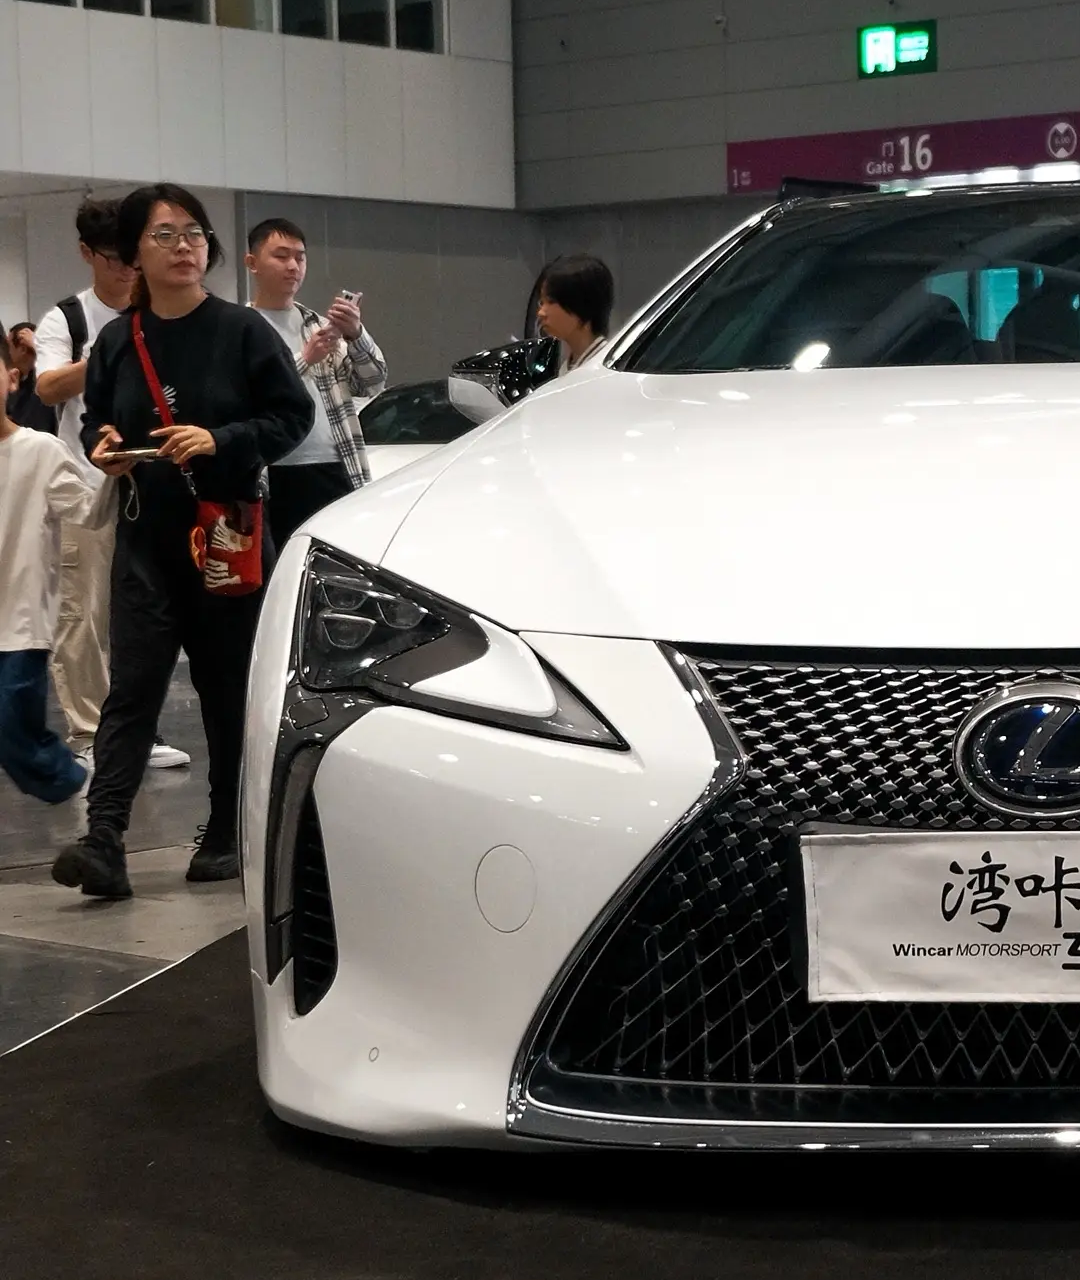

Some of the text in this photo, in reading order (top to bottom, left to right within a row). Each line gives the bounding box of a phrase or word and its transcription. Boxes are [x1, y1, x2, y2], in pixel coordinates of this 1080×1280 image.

[899, 133, 933, 172] 16
[866, 160, 895, 175] Gate
[892, 943, 1062, 957] Wincar MOTORSPORT
